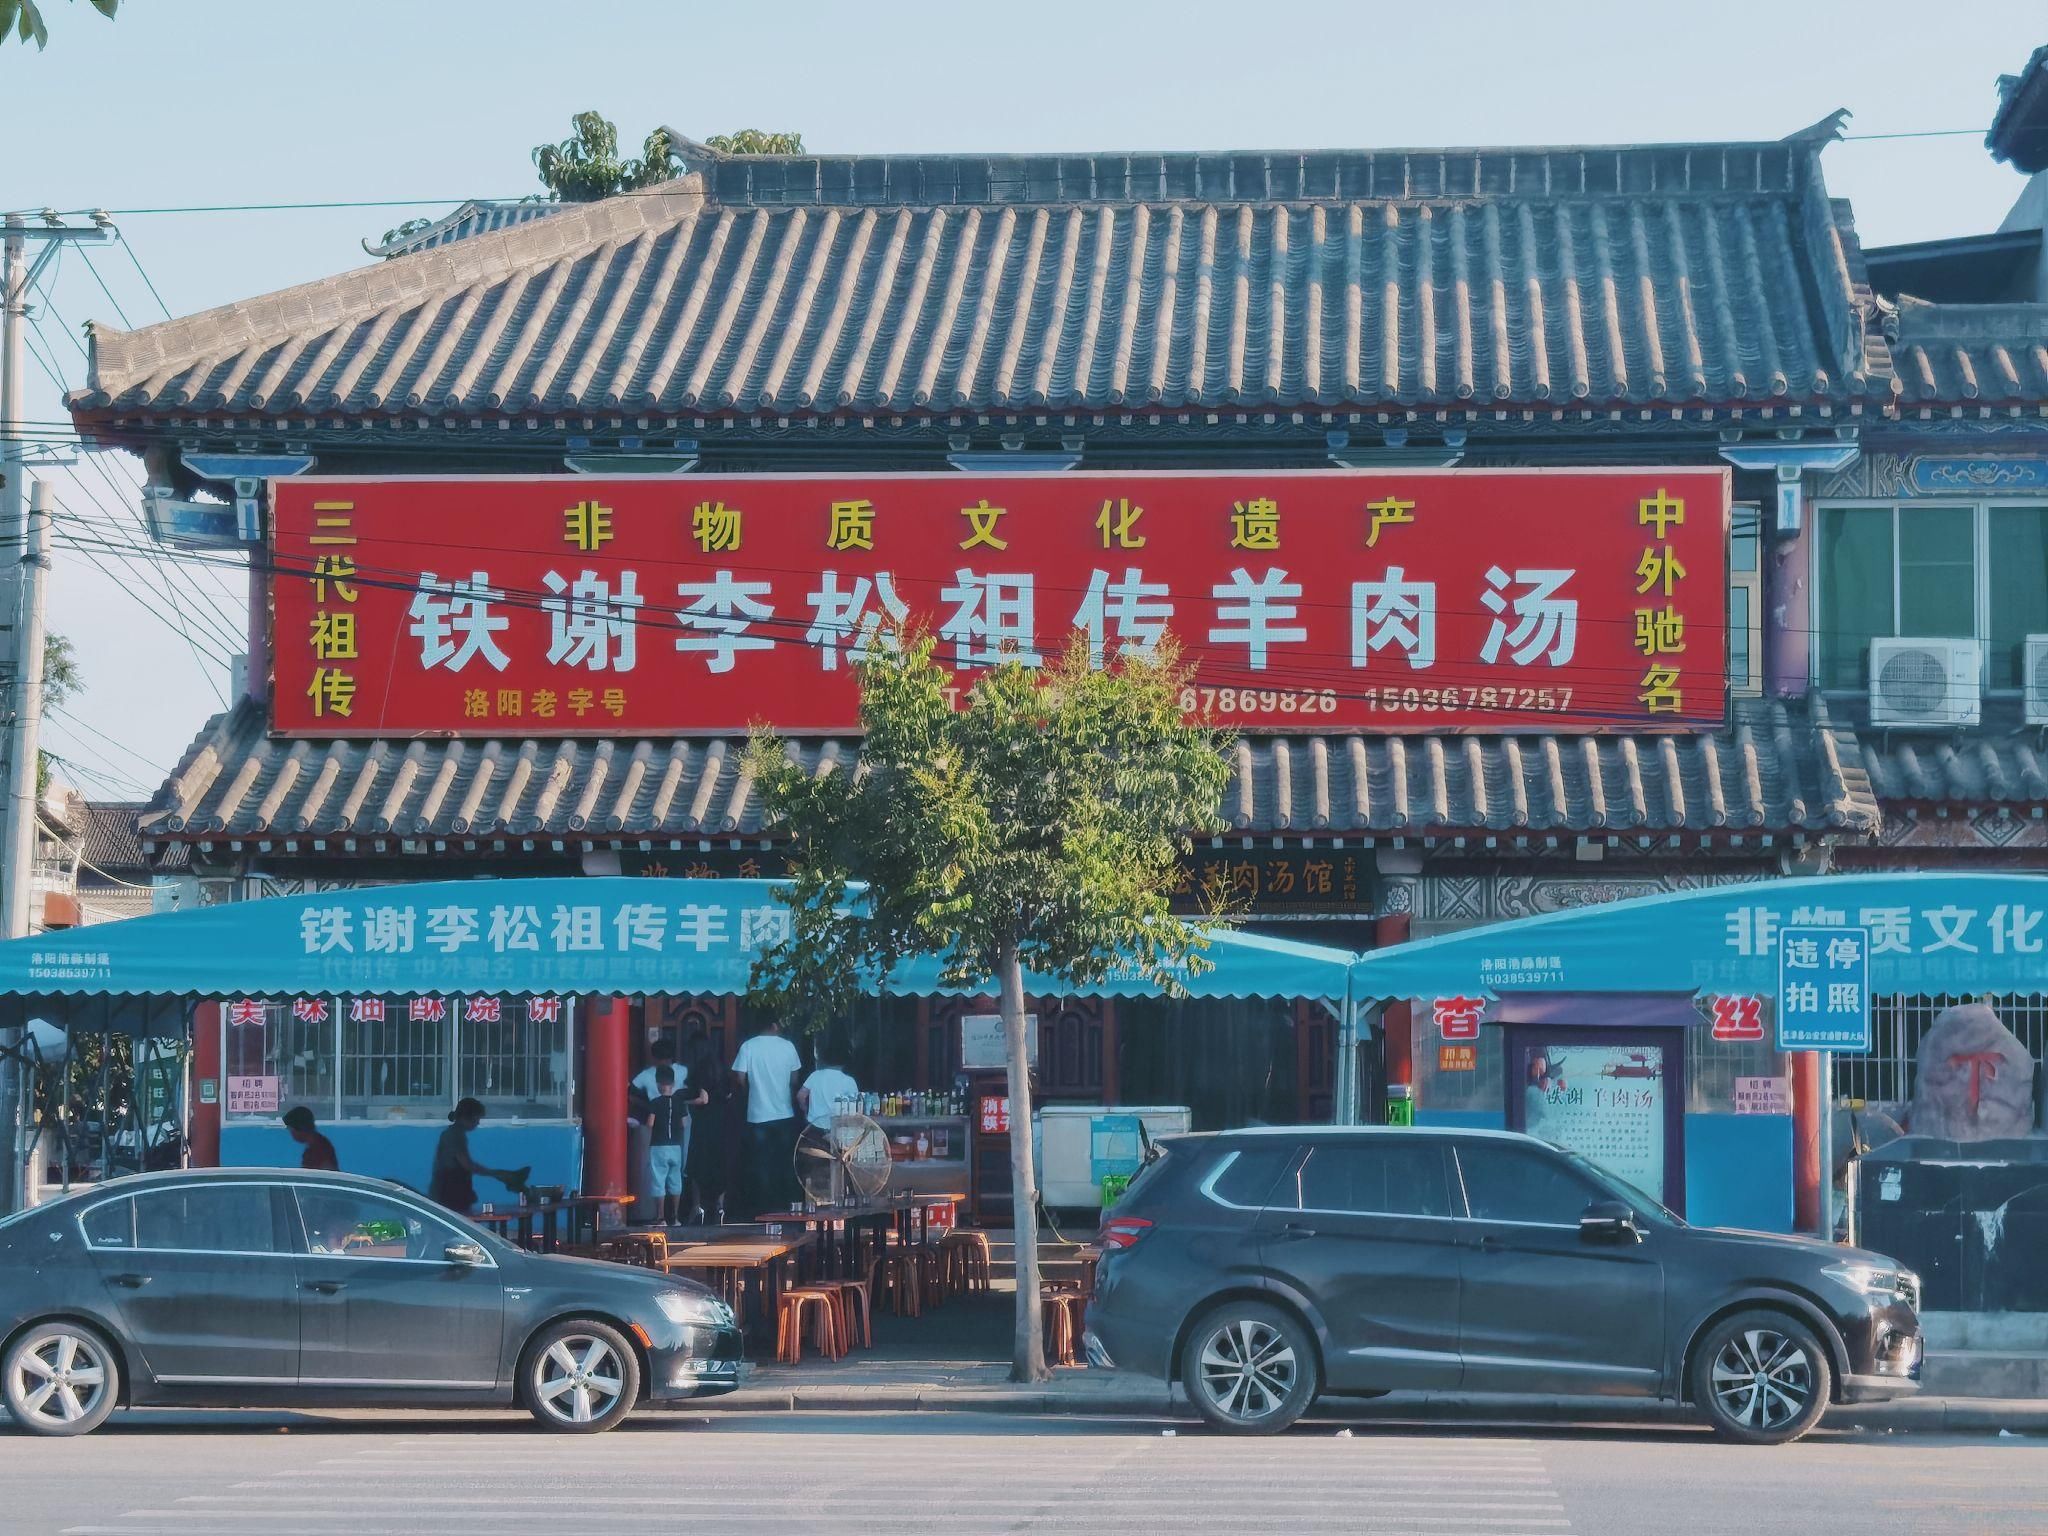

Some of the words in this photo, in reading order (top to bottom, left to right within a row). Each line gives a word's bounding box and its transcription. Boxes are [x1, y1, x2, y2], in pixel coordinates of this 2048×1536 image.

[562, 496, 1417, 552] 非物质文化遗产
[307, 500, 359, 718] 三代祖传
[409, 565, 1580, 674] 铁谢李松祖传羊肉汤
[1633, 488, 1687, 715] 中外驰名
[463, 688, 628, 718] 洛阳老字号
[1364, 686, 1574, 713] 15036787257
[300, 902, 876, 955] 铁谢李松祖传羊肉
[28, 967, 112, 979] 15038539711
[1785, 938, 1861, 970] 违停
[1479, 971, 1565, 985] 15038539711
[1785, 981, 1861, 1014] 拍照
[1432, 994, 1487, 1040] 香
